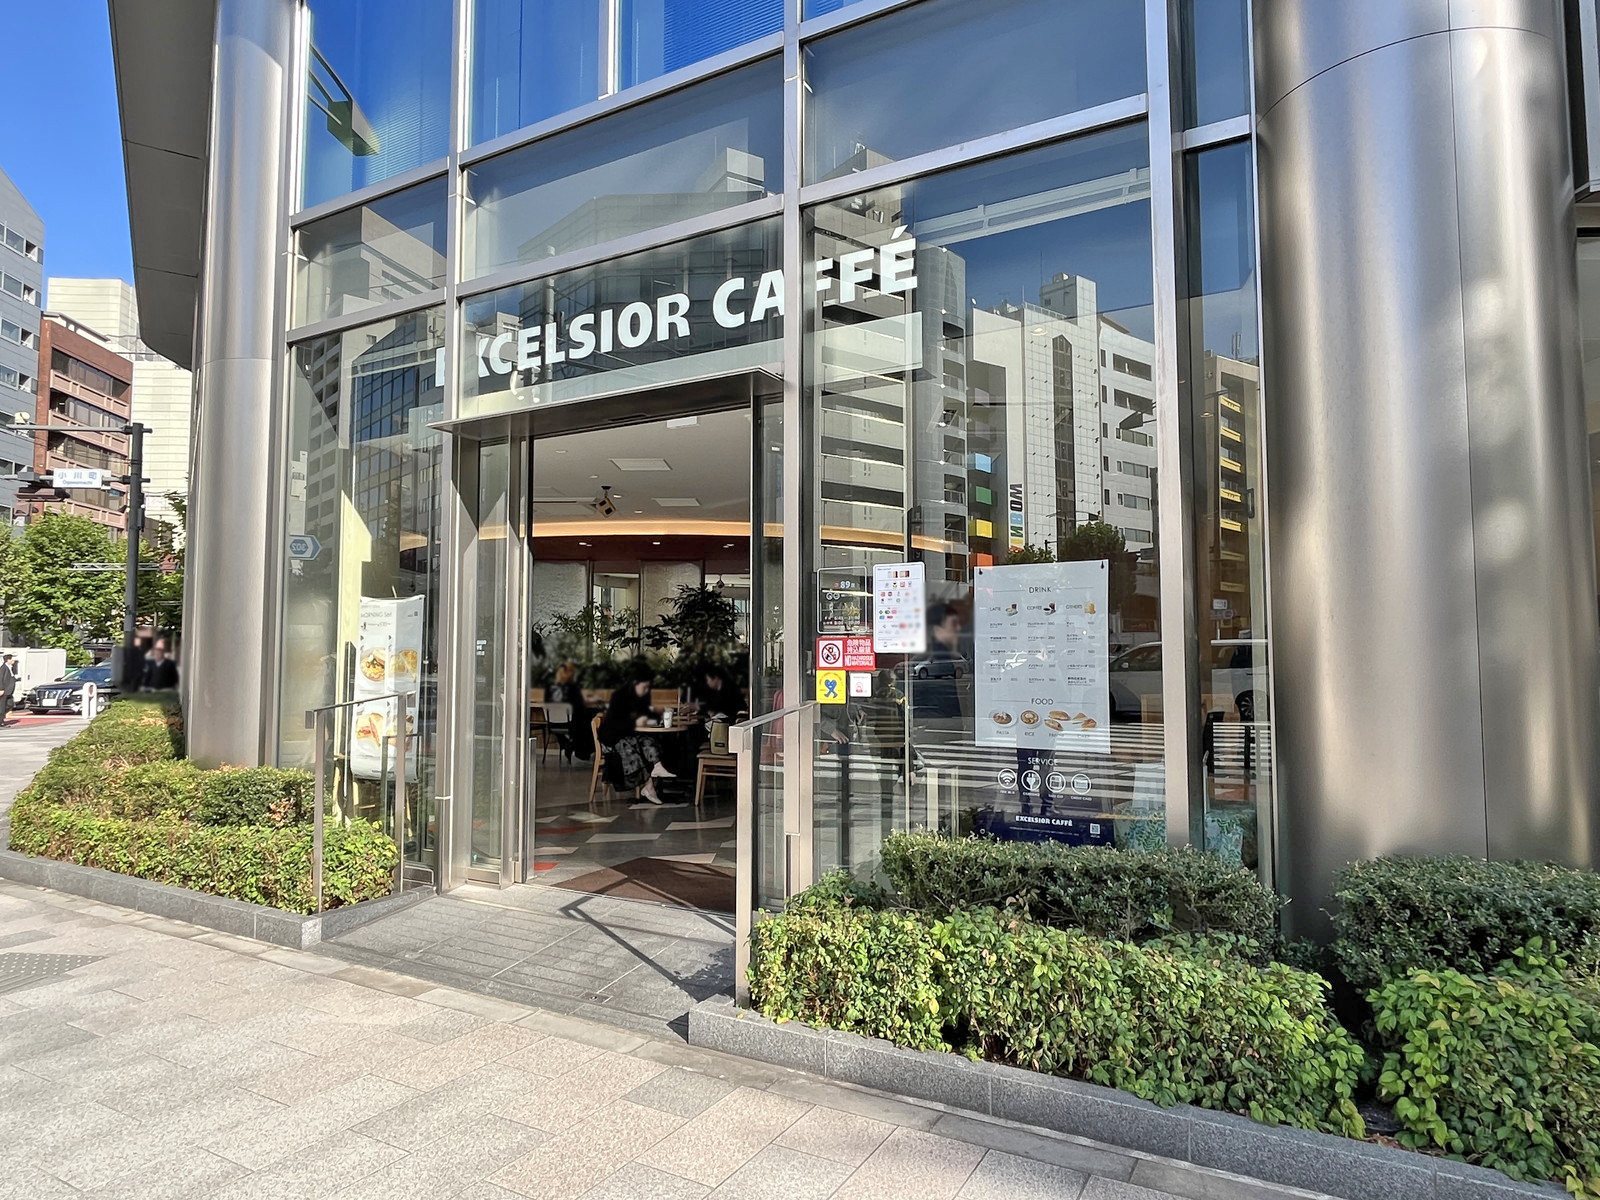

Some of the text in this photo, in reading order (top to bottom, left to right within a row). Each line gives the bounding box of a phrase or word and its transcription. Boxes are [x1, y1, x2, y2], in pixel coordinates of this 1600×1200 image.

[1028, 586, 1052, 594] DRINK
[1027, 757, 1059, 766] SERVICE
[1015, 815, 1050, 825] EXCELSIOR
